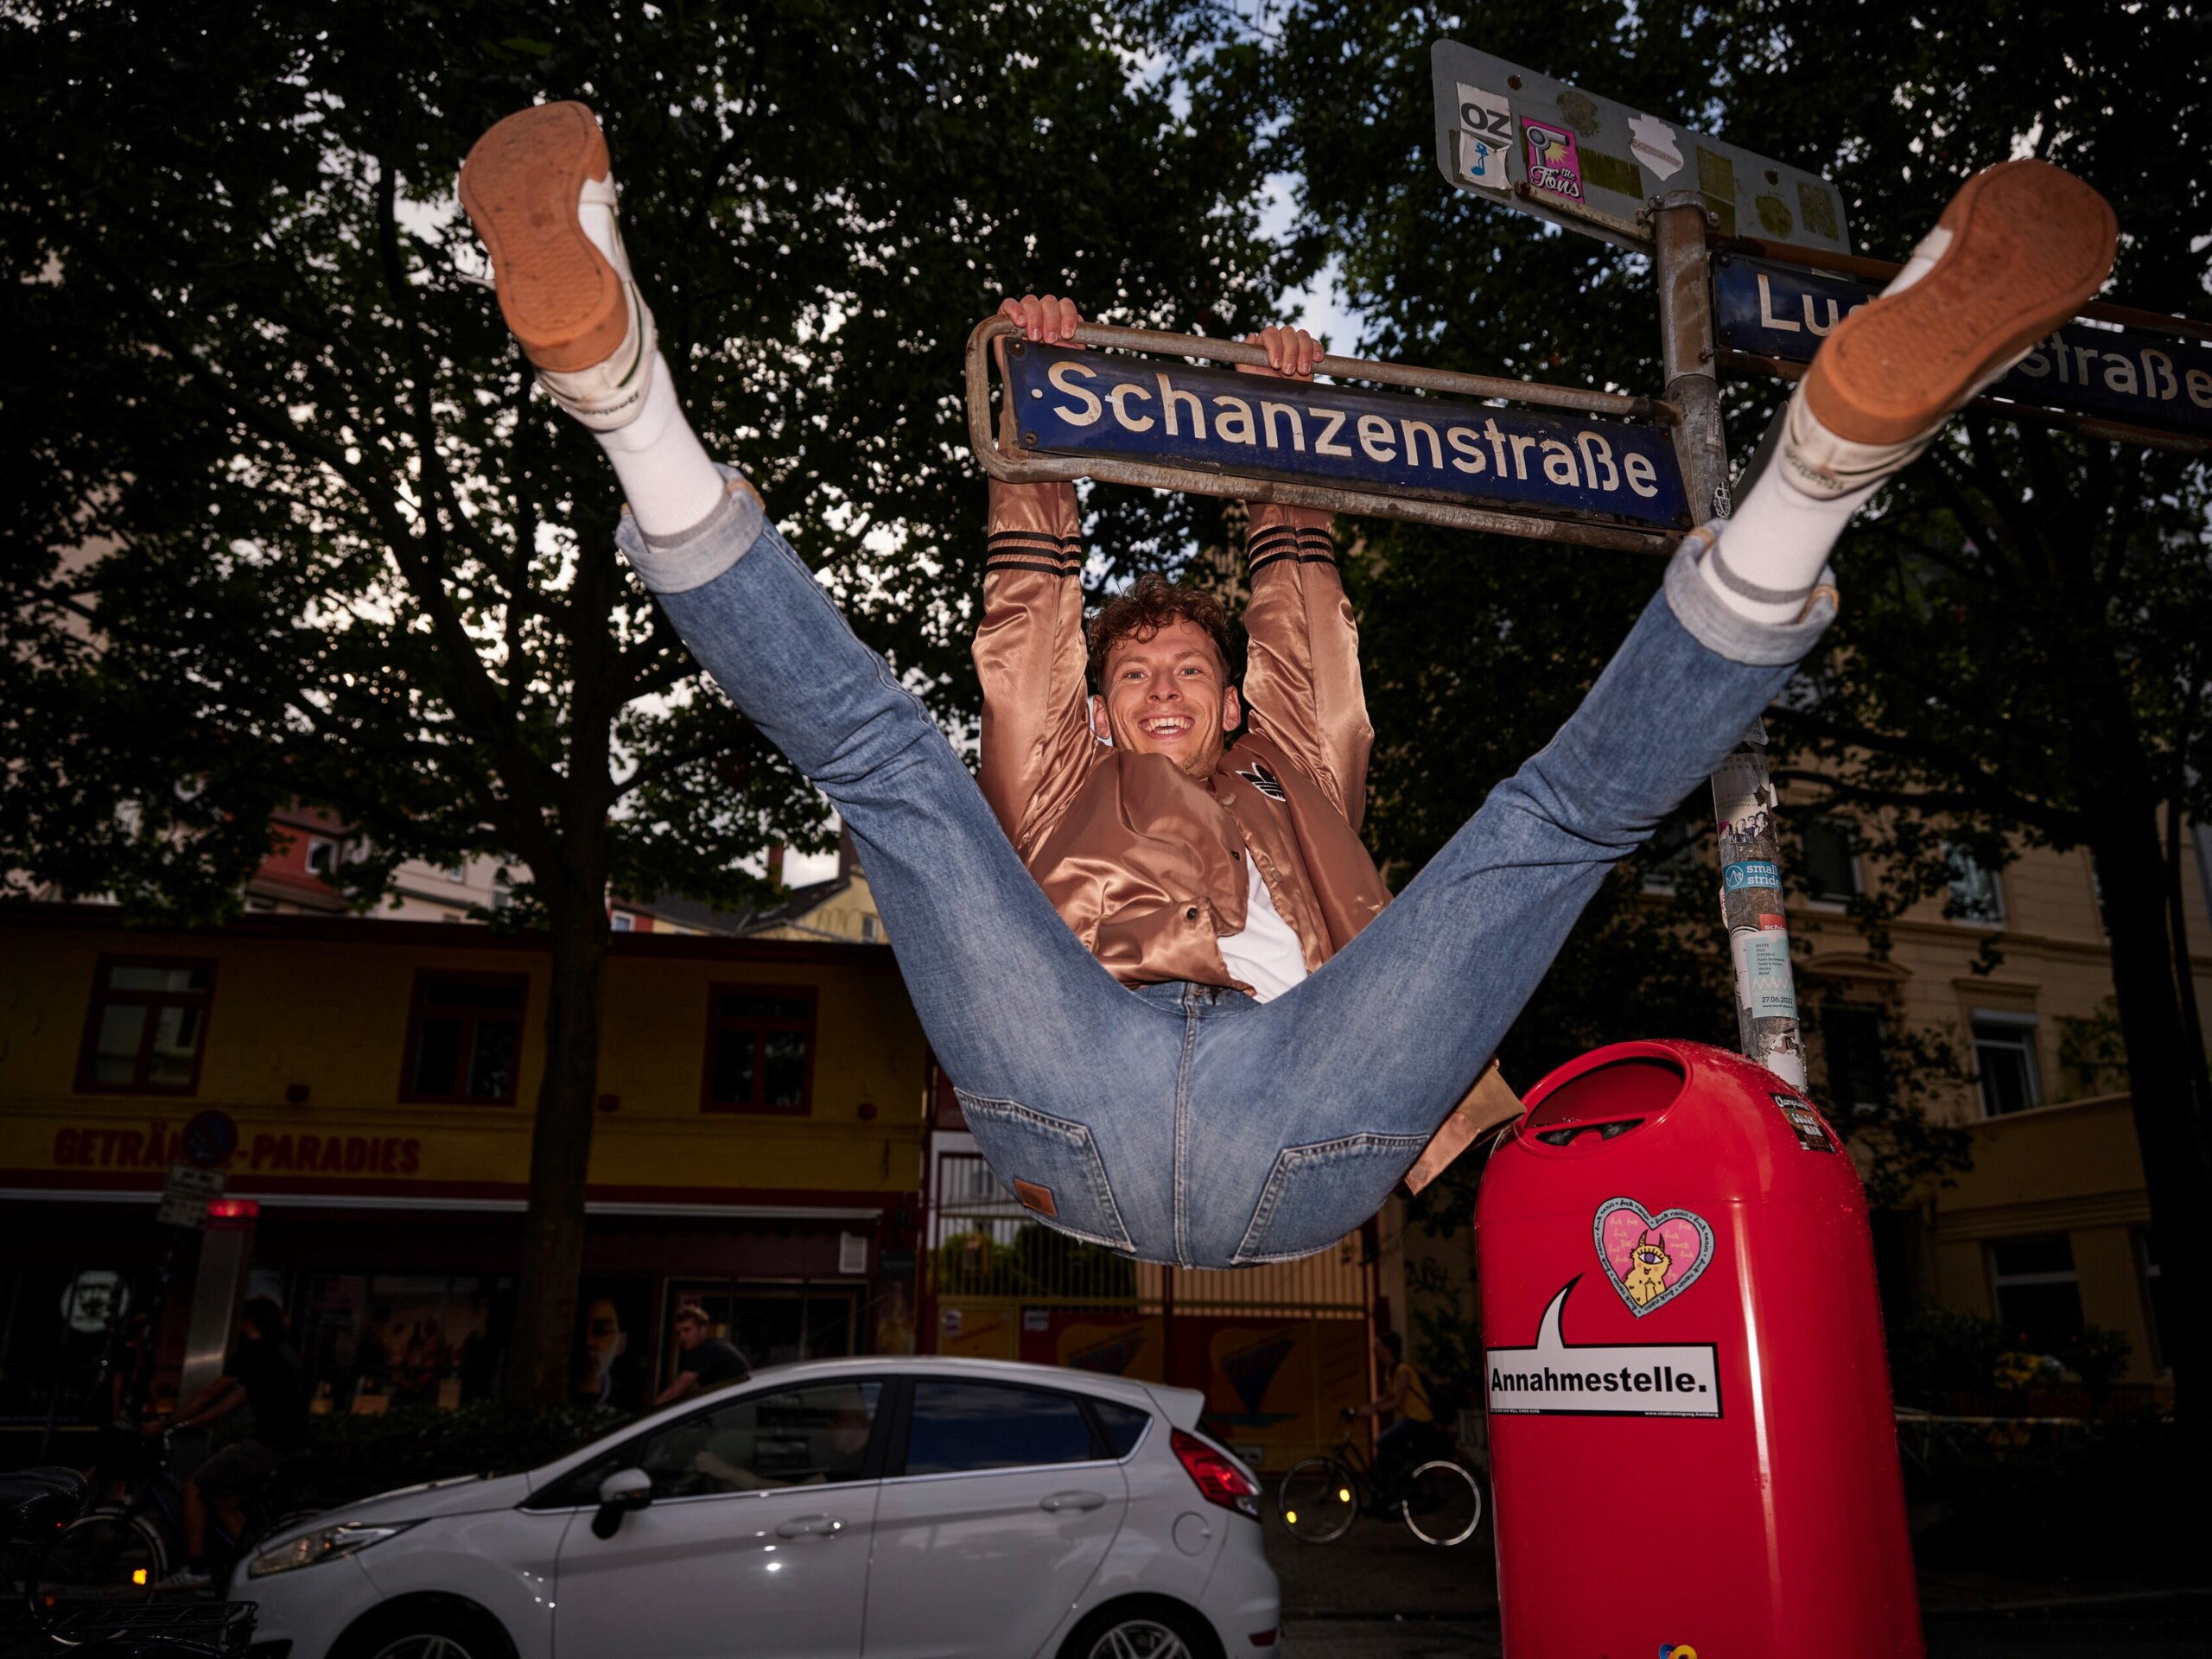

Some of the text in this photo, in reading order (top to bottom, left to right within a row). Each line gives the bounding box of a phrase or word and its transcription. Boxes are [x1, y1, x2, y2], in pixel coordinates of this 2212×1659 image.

[1047, 360, 1659, 499] Schanzenstraße
[1746, 864, 1778, 876] small
[1762, 995, 1794, 1005] 27.08.2022
[1491, 1366, 1707, 1393] Annahmestelle.
